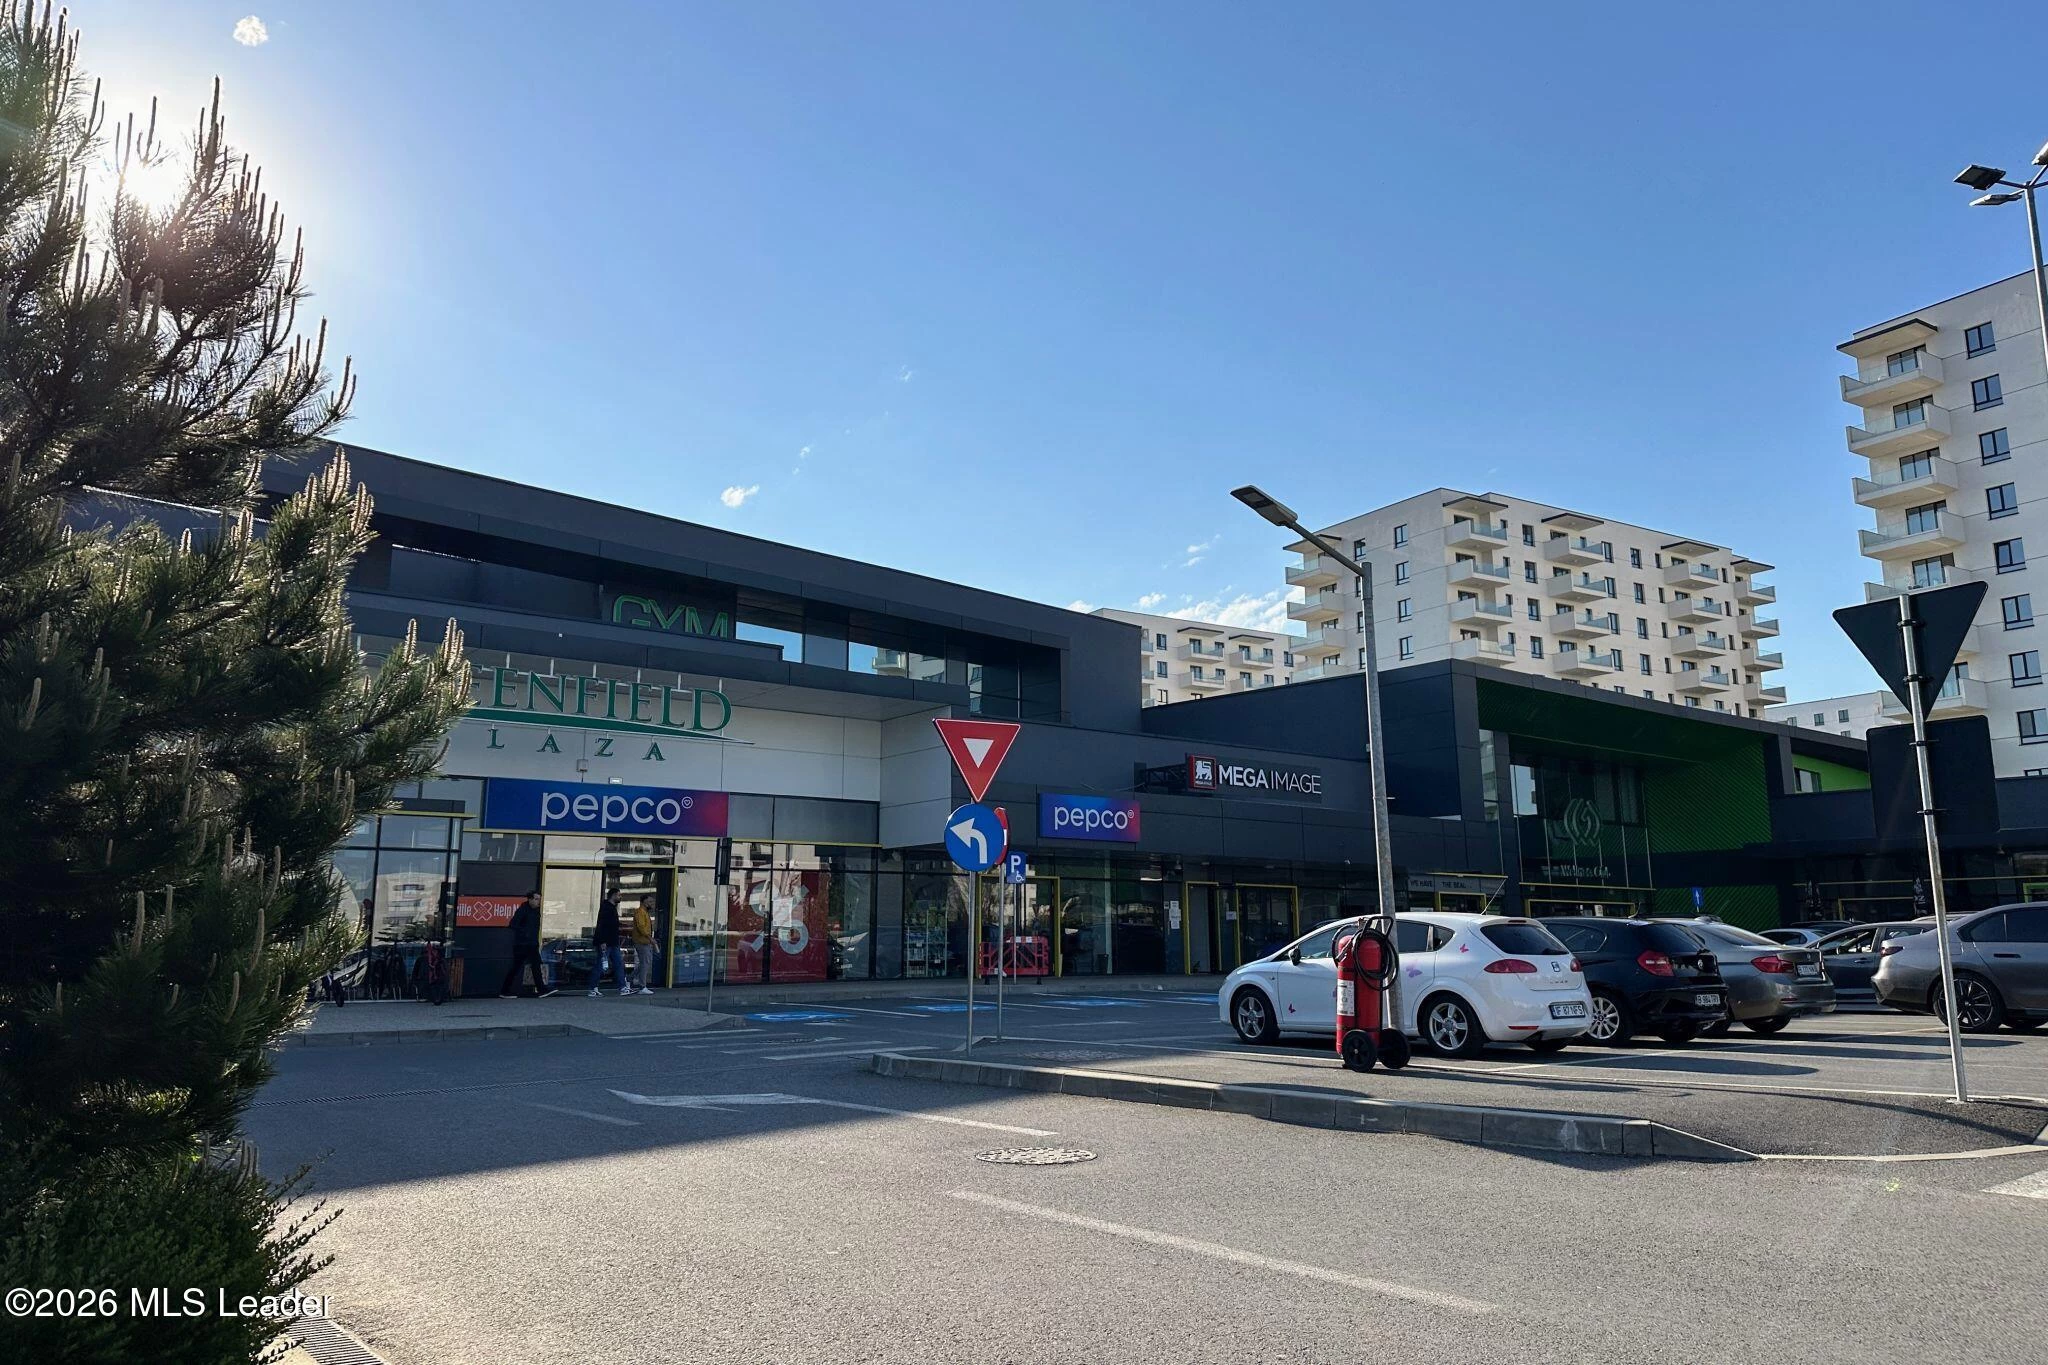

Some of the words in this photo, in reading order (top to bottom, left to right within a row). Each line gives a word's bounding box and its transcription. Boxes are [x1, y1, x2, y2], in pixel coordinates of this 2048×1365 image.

[487, 727, 666, 761] LAZA
[1218, 764, 1269, 789] MEGA
[1270, 770, 1322, 794] IMAGE
[541, 792, 681, 829] pepco
[1054, 806, 1128, 832] pepco
[1010, 855, 1021, 873] P
[494, 903, 512, 919] Help
